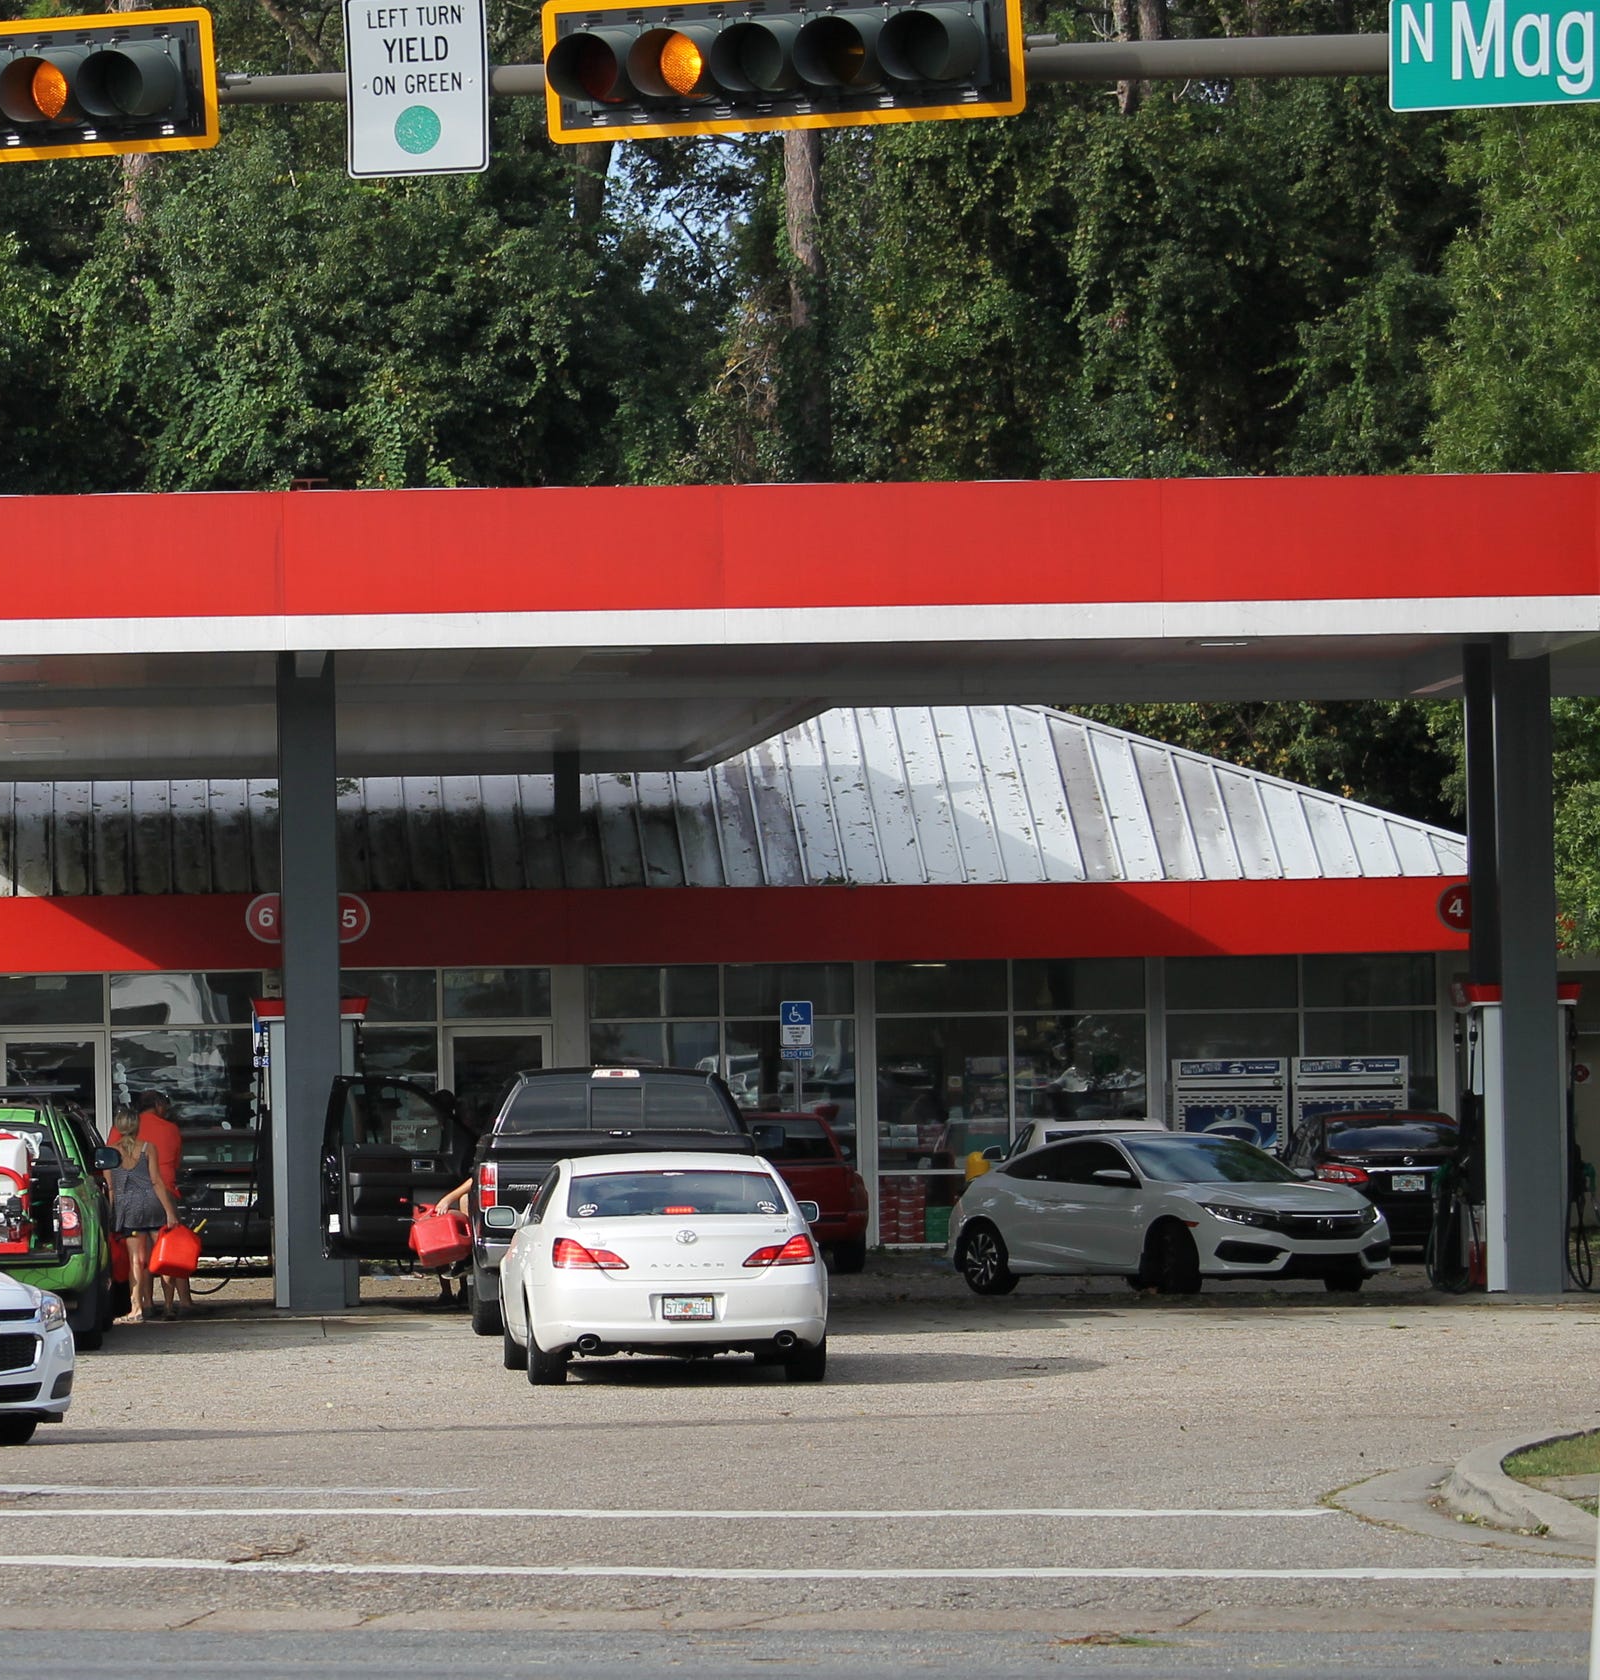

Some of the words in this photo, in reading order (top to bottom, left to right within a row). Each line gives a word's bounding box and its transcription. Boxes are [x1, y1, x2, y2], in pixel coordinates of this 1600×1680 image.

[367, 8, 408, 29] LEFT
[416, 5, 462, 26] TURN
[383, 35, 449, 63] YIELD
[1401, 2, 1433, 64] N
[1451, 0, 1594, 95] Mag
[372, 75, 396, 96] ON
[404, 72, 462, 94] GREEN
[258, 907, 274, 927] 6
[342, 908, 358, 928] 5
[1448, 898, 1464, 917] 4
